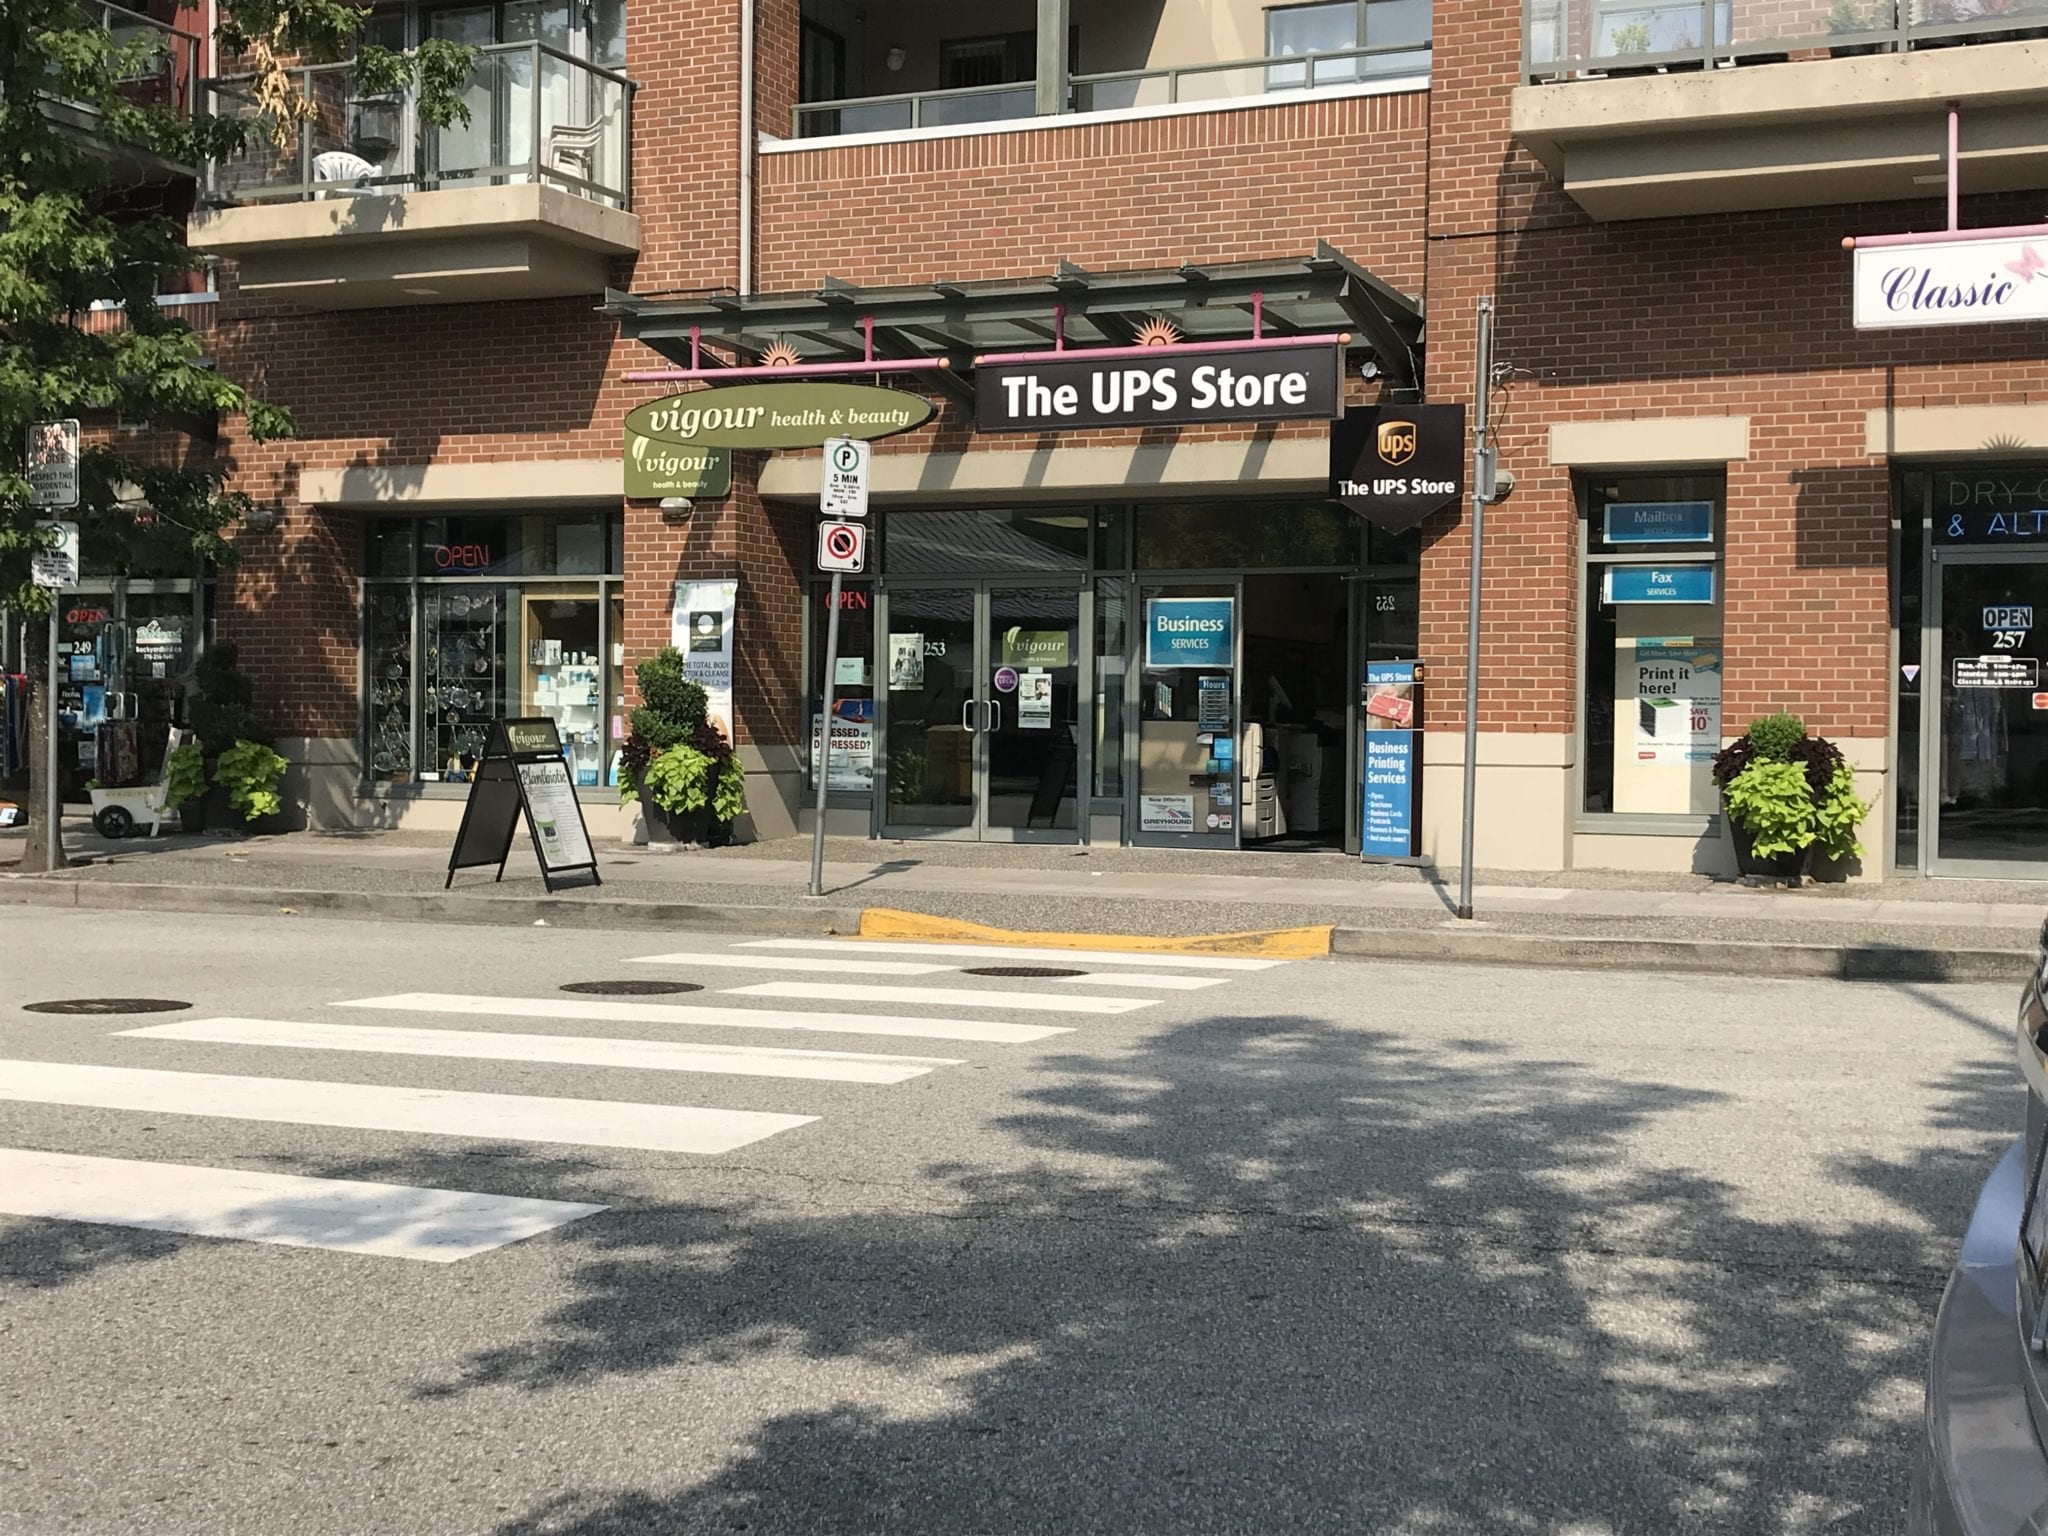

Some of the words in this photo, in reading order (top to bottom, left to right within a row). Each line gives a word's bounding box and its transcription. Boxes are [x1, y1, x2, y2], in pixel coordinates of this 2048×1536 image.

[1881, 267, 2018, 311] Classic
[1002, 376, 1078, 417] The
[1092, 368, 1177, 413] UPS
[1191, 366, 1307, 408] Store
[649, 399, 764, 438] vigour
[771, 411, 825, 426] health
[829, 410, 843, 424] &
[848, 408, 909, 426] beauty
[1381, 434, 1413, 459] ups
[645, 451, 720, 476] vigour
[59, 471, 73, 479] THIS
[833, 474, 839, 482] 5
[842, 474, 858, 483] MIN
[683, 481, 708, 489] beauty
[1338, 480, 1369, 495] The
[1373, 480, 1407, 494] UPS
[1411, 479, 1455, 494] Store
[44, 490, 61, 499] AREA
[1951, 481, 2021, 505] DRY
[1634, 512, 1684, 523] Mailbox
[1947, 513, 1965, 536] &
[435, 545, 488, 567] OPEN
[1651, 572, 1672, 583] Fax
[1647, 588, 1677, 596] SERVICES
[66, 609, 106, 623] OPEN
[1985, 609, 2030, 627] OPEN
[1157, 615, 1224, 632] Business
[1017, 639, 1064, 654] vigour
[1172, 638, 1208, 649] SERVICES
[1993, 632, 2026, 648] 257
[74, 641, 91, 654] 249
[924, 642, 946, 656] 253
[1368, 673, 1380, 682] The
[1381, 673, 1394, 682] UPS
[1395, 673, 1412, 681] Store
[1640, 668, 1674, 679] Print
[1679, 668, 1689, 679] it
[1203, 680, 1225, 689] Hours
[1640, 682, 1676, 694] here!
[515, 731, 546, 746] vigour
[1369, 742, 1408, 754] Business
[1368, 757, 1405, 772] Printing
[1368, 771, 1406, 784] Services
